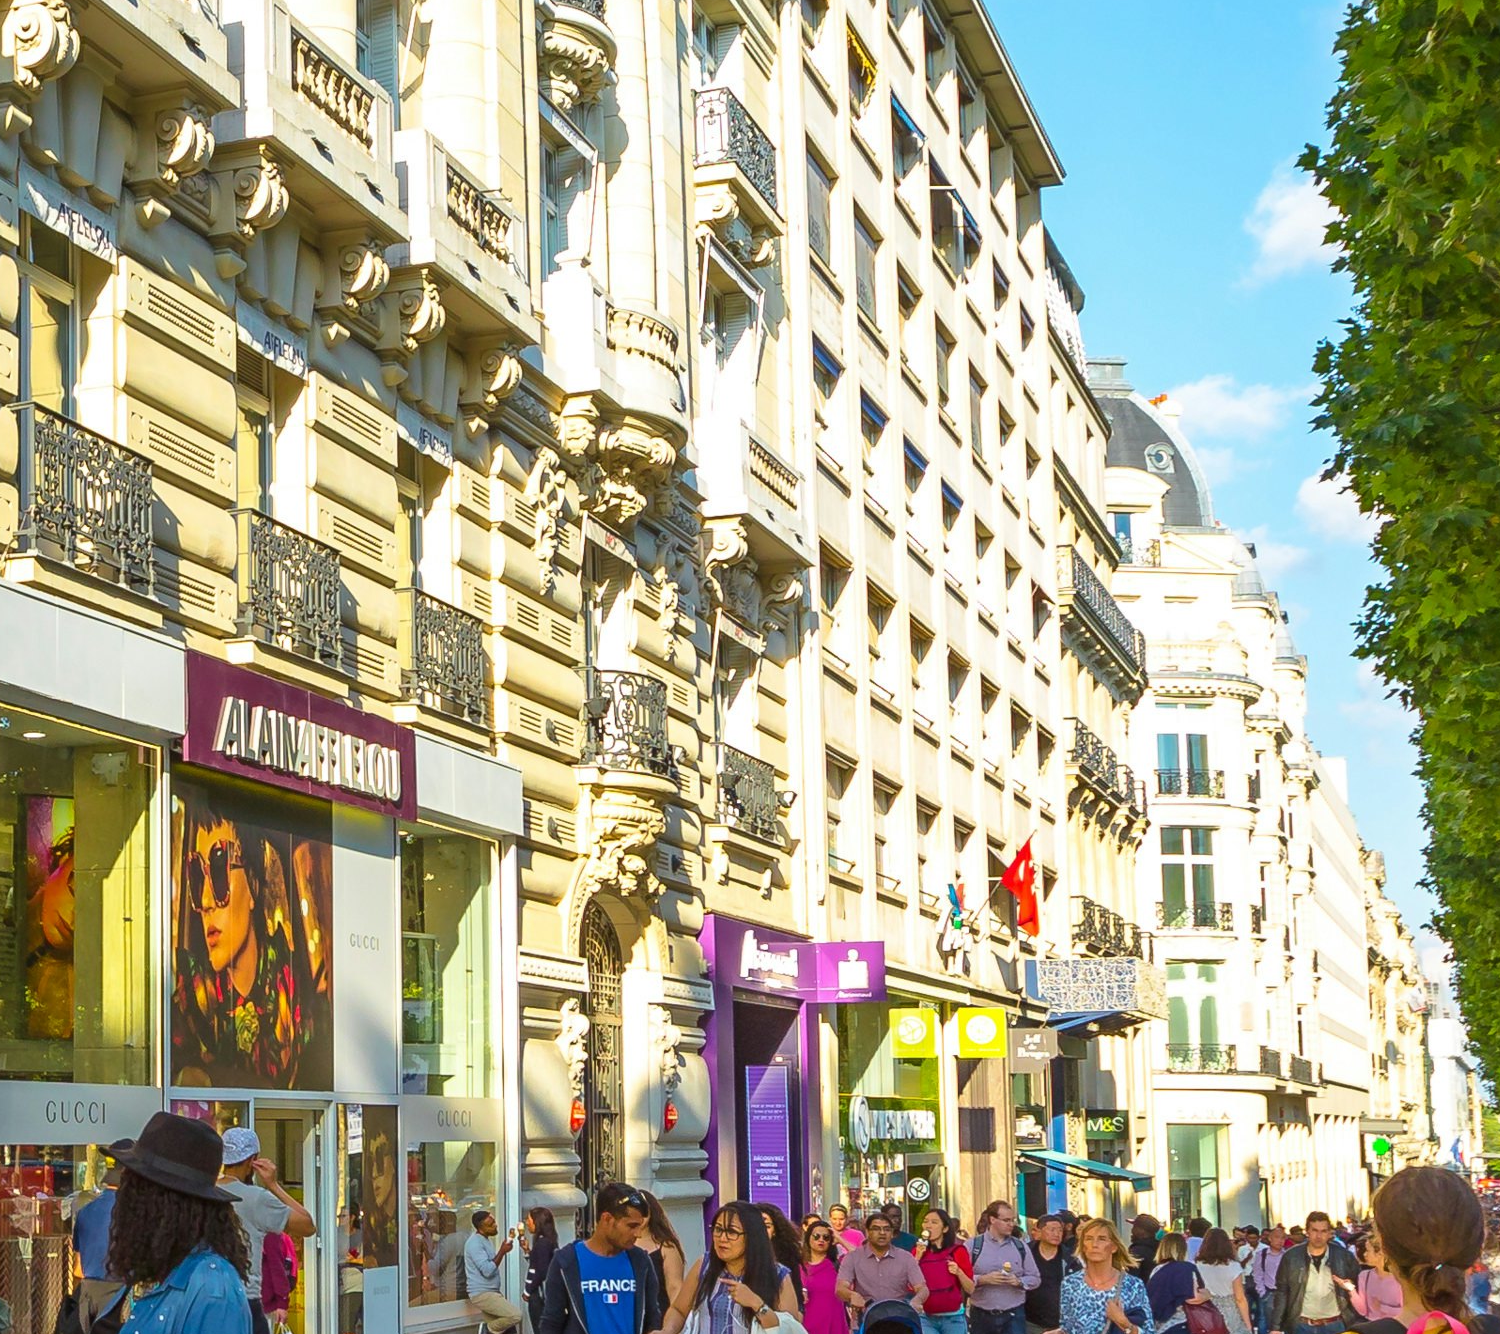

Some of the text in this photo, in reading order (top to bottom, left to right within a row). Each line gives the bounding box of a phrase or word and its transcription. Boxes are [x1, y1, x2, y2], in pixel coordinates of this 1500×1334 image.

[349, 933, 380, 952] GUCCI
[45, 1100, 107, 1124] GUCCI
[437, 1110, 472, 1128] GUCCI
[1087, 1116, 1125, 1133] M&S
[581, 1278, 637, 1294] FRANCE
